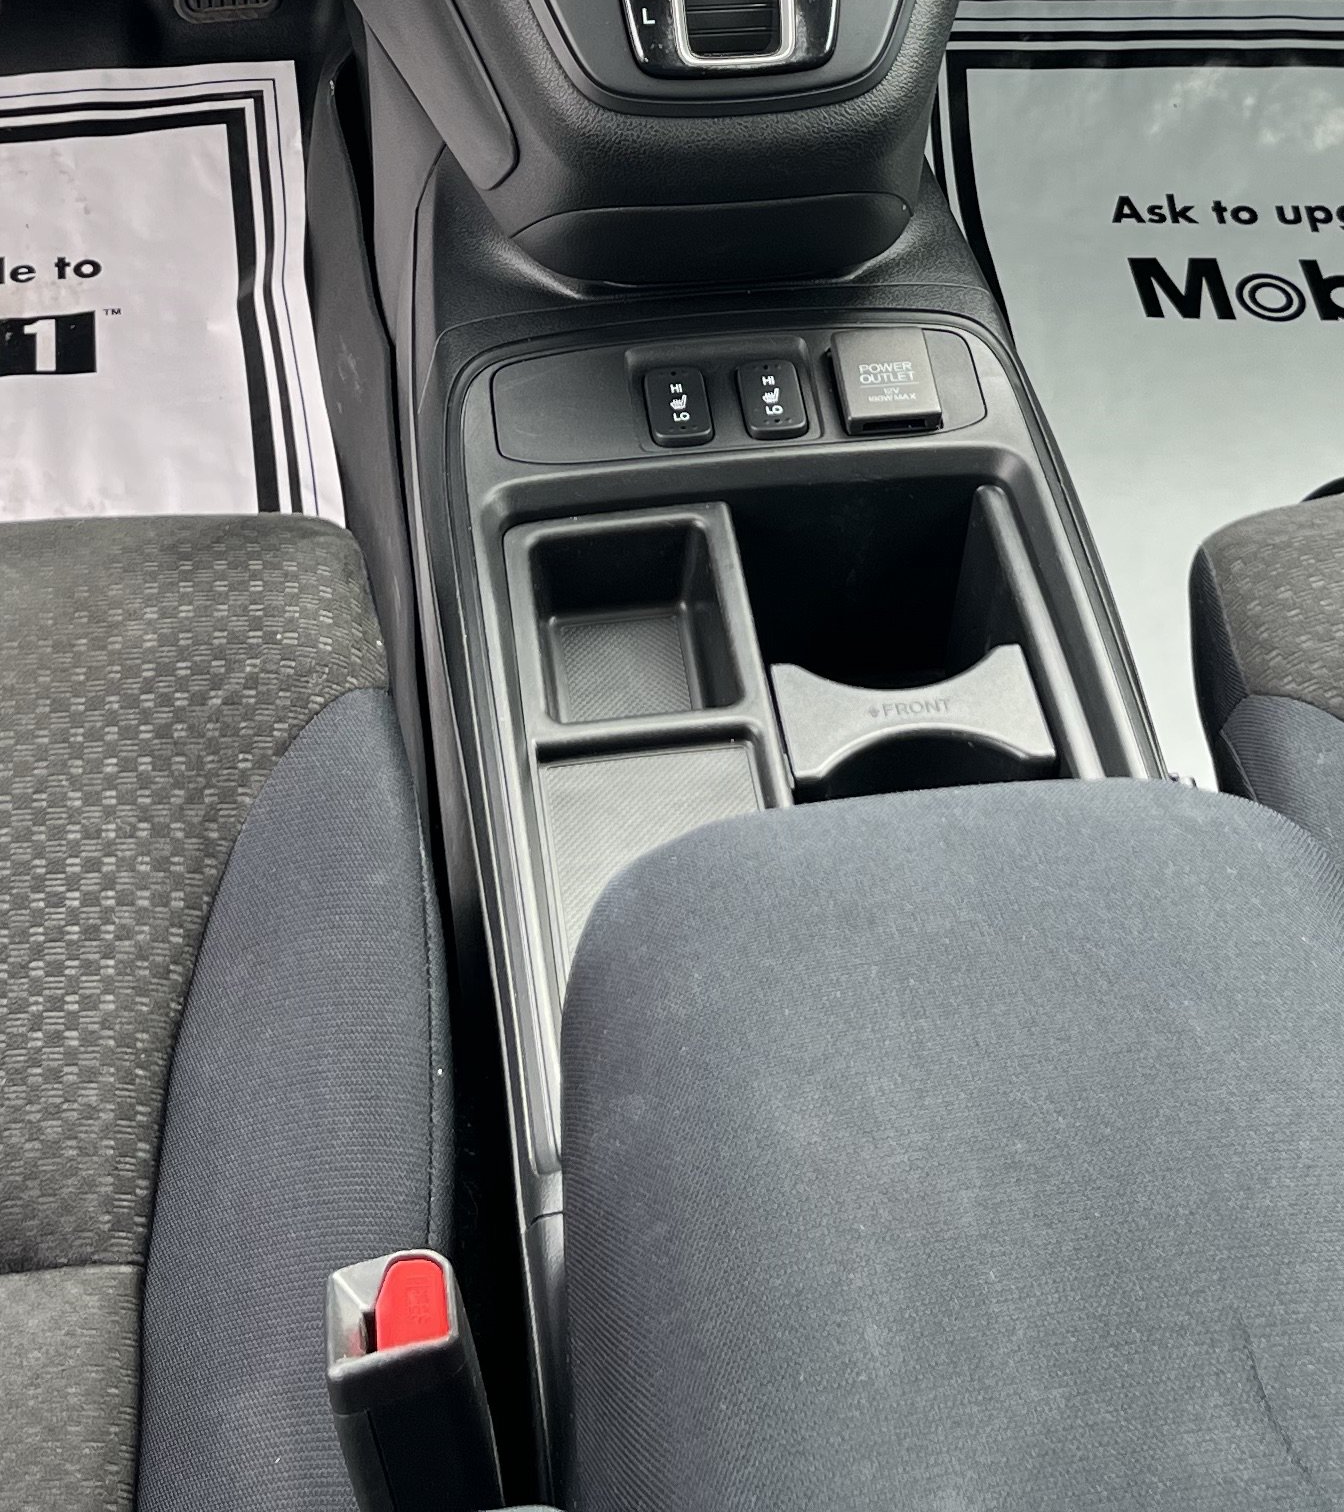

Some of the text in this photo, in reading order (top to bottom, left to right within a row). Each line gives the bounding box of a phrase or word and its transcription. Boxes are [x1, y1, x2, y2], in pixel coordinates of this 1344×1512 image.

[641, 7, 655, 25] L
[1112, 193, 1199, 224] Ask
[1211, 199, 1258, 225] to
[54, 255, 103, 279] to
[858, 360, 913, 374] POWER
[761, 375, 776, 386] HI
[859, 370, 916, 384] OUTLET
[670, 383, 683, 394] HI
[672, 411, 691, 422] LO
[765, 405, 784, 416] LO
[882, 697, 951, 718] FRONT
